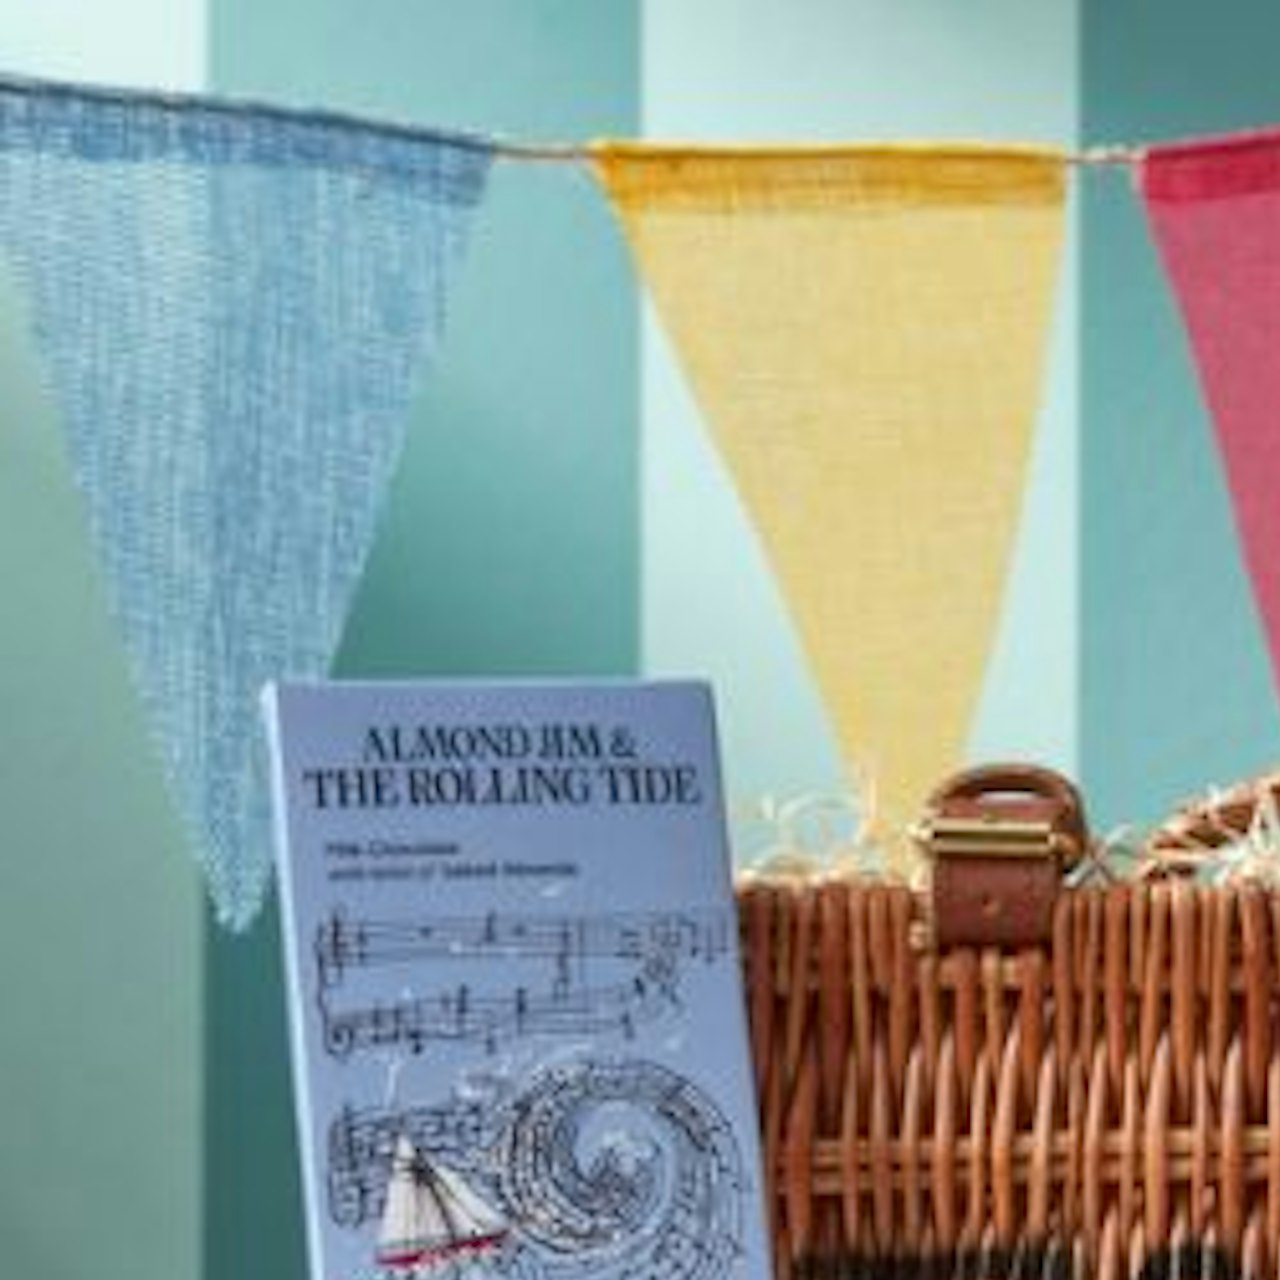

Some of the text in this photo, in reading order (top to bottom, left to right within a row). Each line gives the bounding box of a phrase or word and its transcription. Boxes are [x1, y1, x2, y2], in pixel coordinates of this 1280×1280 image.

[361, 725, 533, 763] ALMOND
[606, 725, 637, 759] &
[305, 765, 702, 809] THE ROLLING TIDE
